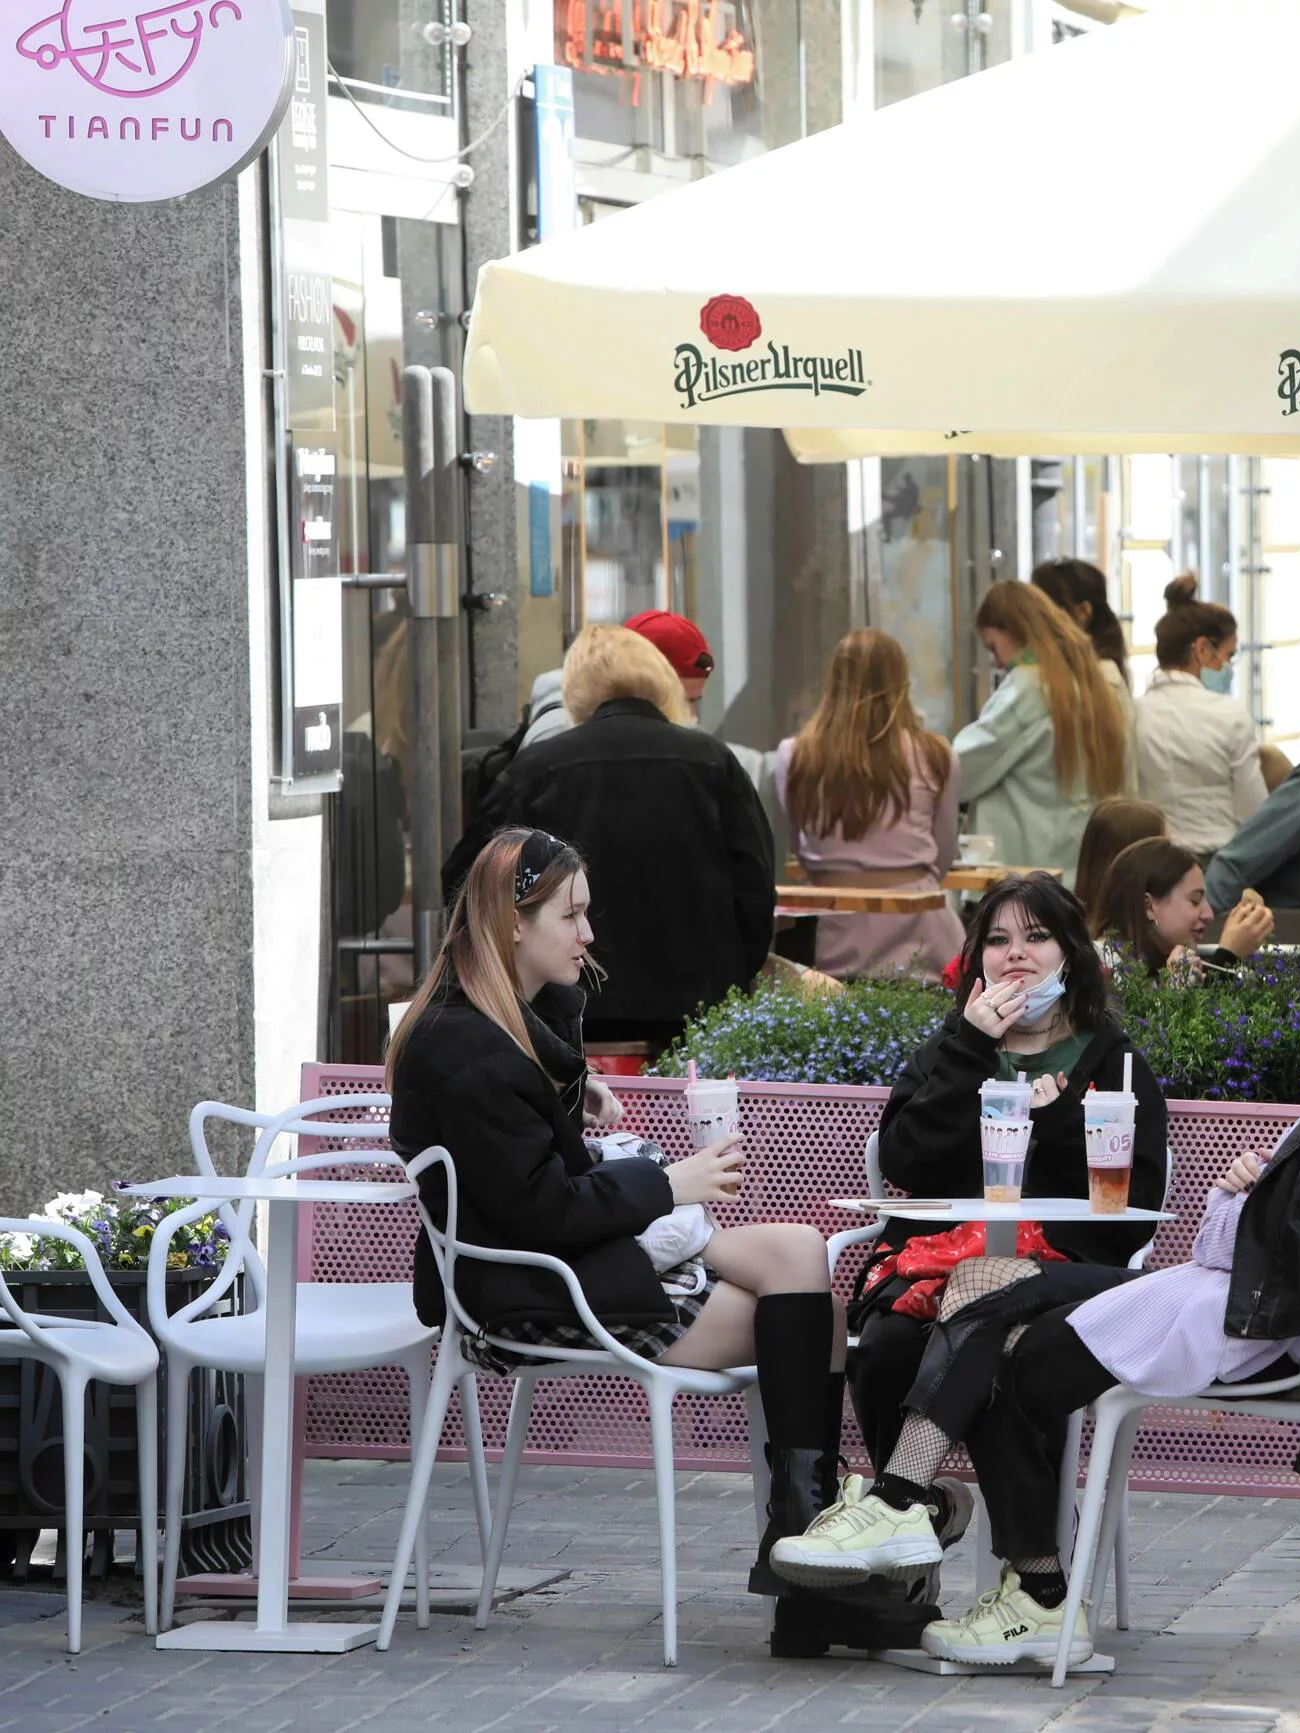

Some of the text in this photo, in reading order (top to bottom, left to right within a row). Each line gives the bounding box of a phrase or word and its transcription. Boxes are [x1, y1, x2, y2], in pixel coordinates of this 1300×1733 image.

[38, 114, 233, 142] TIANFUN
[288, 274, 331, 325] FASHION
[673, 340, 865, 409] Pilsner Urquell
[1109, 1134, 1132, 1153] 05
[1002, 1624, 1029, 1641] FILA
